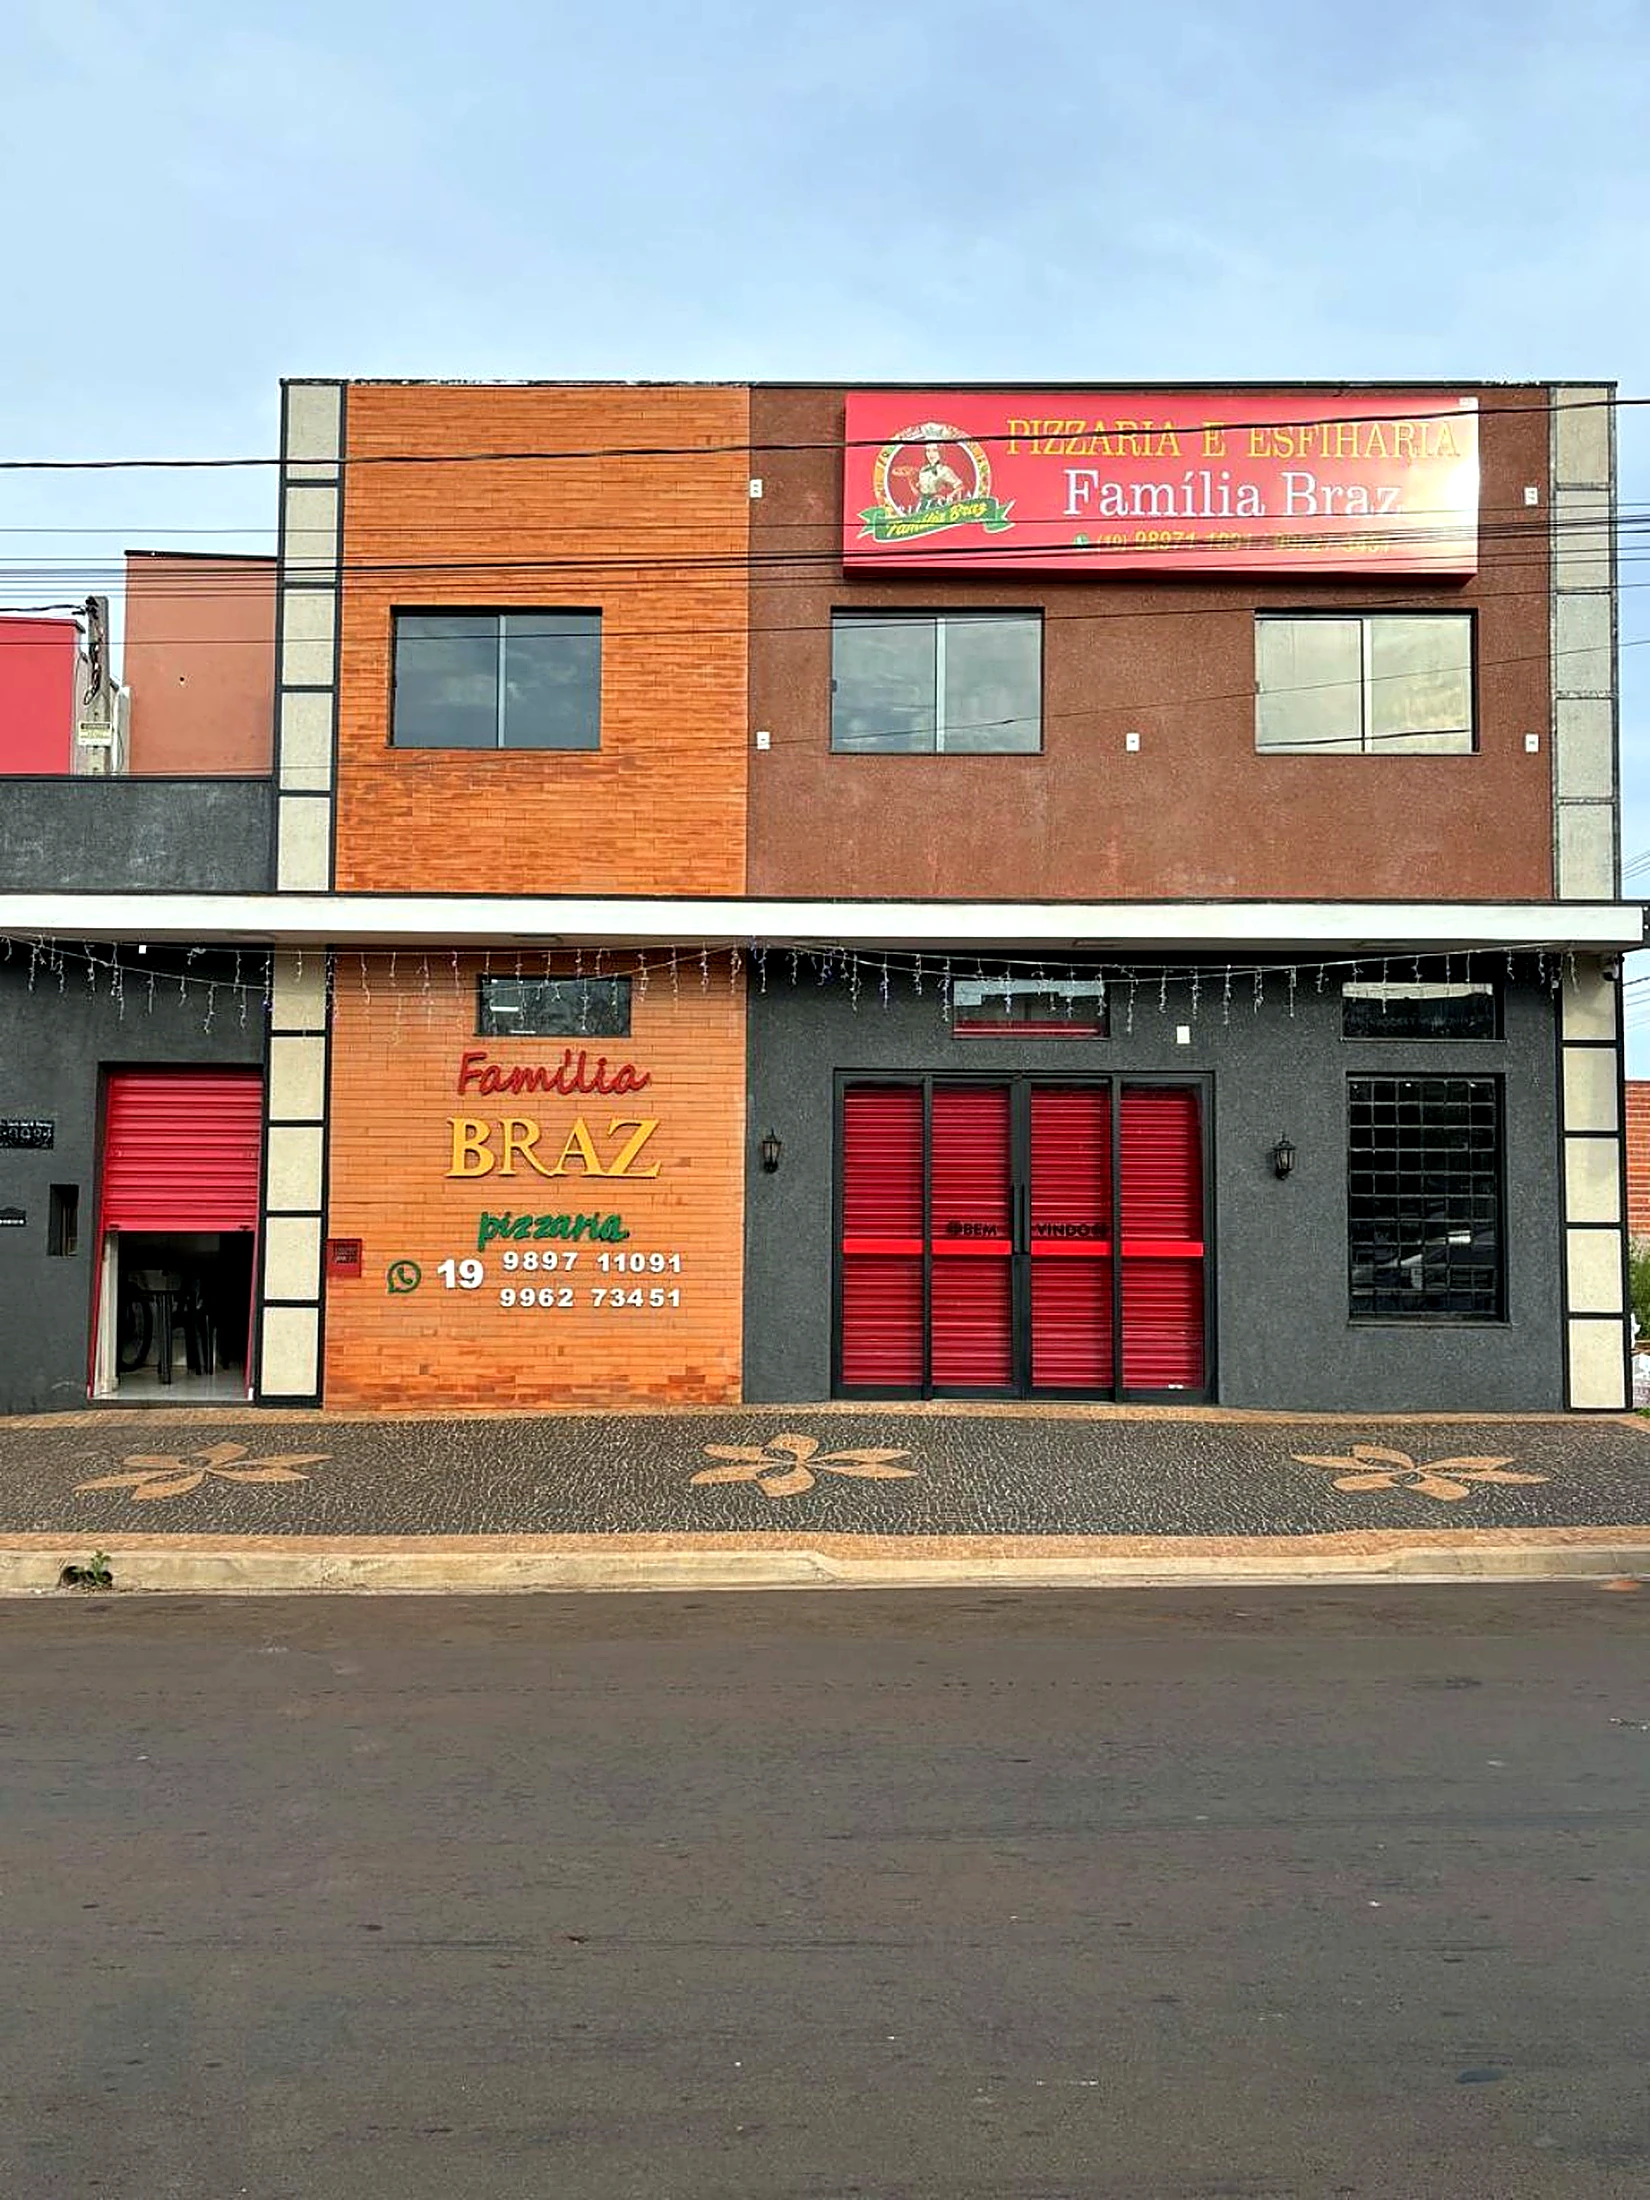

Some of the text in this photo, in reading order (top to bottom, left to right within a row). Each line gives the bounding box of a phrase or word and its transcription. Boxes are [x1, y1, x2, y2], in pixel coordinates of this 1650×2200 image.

[1007, 419, 1460, 459] PIZZARIA E ESFIHARIA
[1064, 468, 1402, 518] Família Braz
[446, 1117, 661, 1178] BRAZ
[478, 1212, 629, 1252] pizzaria
[962, 1223, 997, 1236] BEM
[436, 1252, 682, 1289] 19 9897 11091
[499, 1289, 682, 1308] 9962 73451
